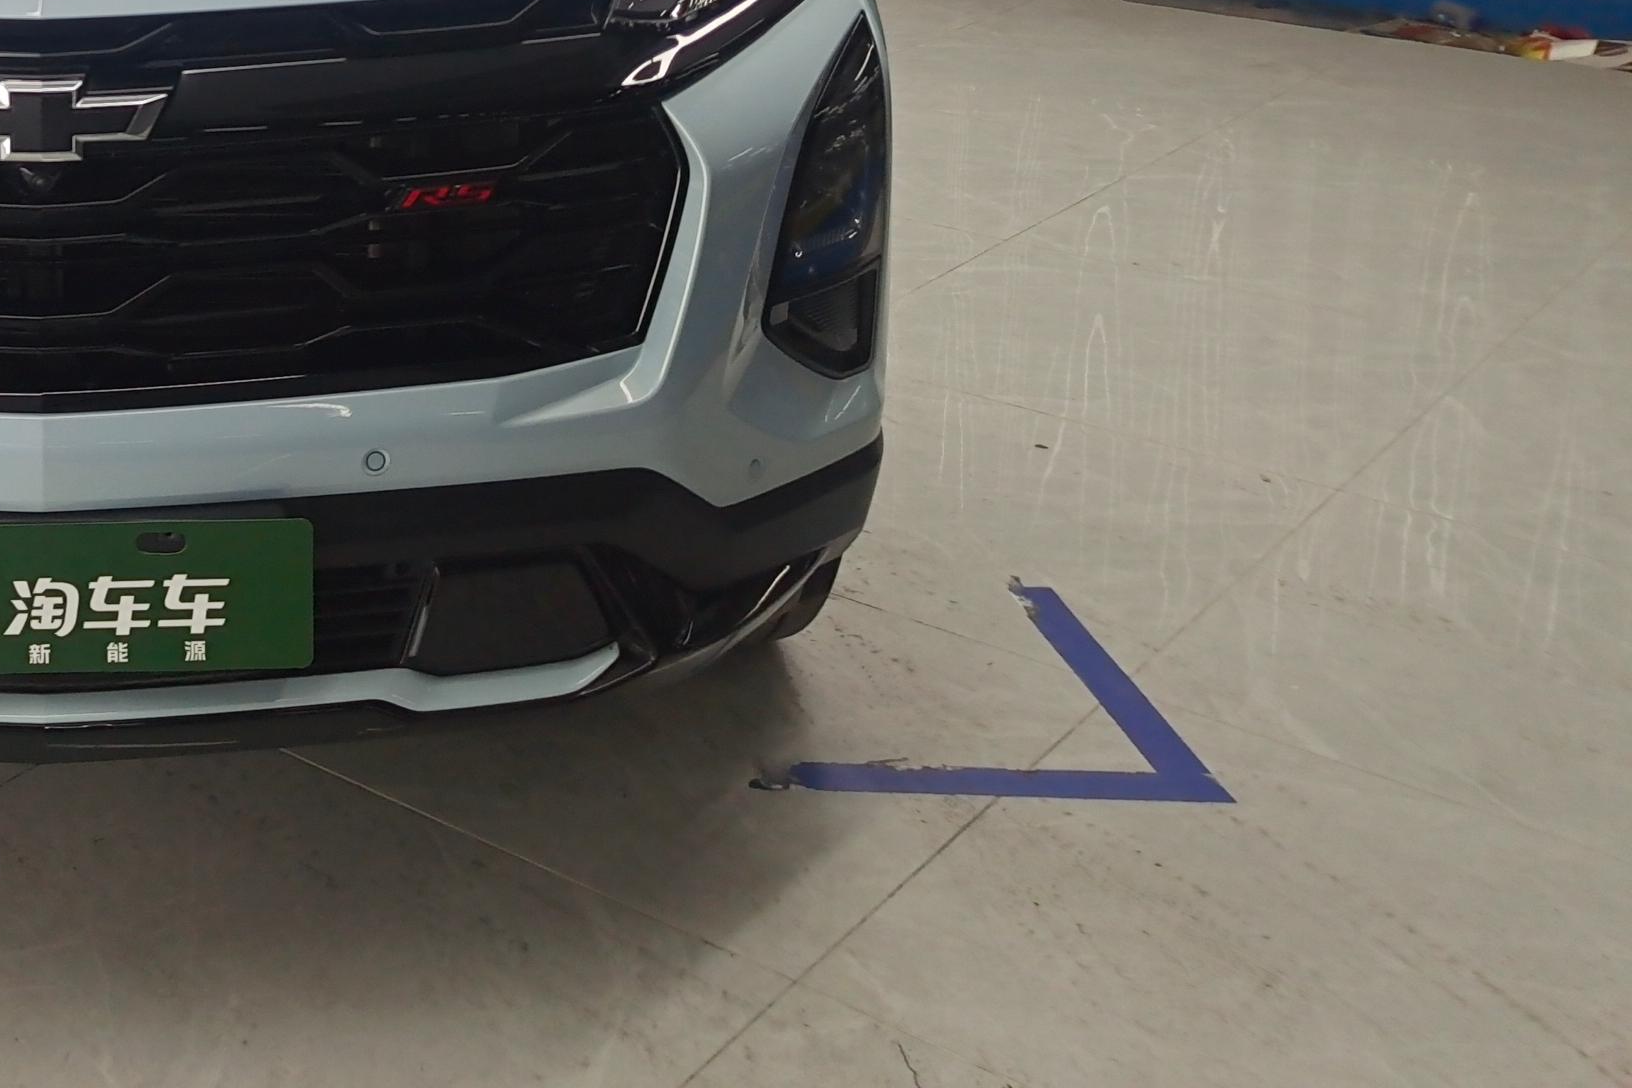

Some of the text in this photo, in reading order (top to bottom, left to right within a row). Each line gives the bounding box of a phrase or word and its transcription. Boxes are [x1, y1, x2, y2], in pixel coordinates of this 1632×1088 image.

[3, 574, 231, 638] 淘车车
[28, 640, 207, 665] 新能源
